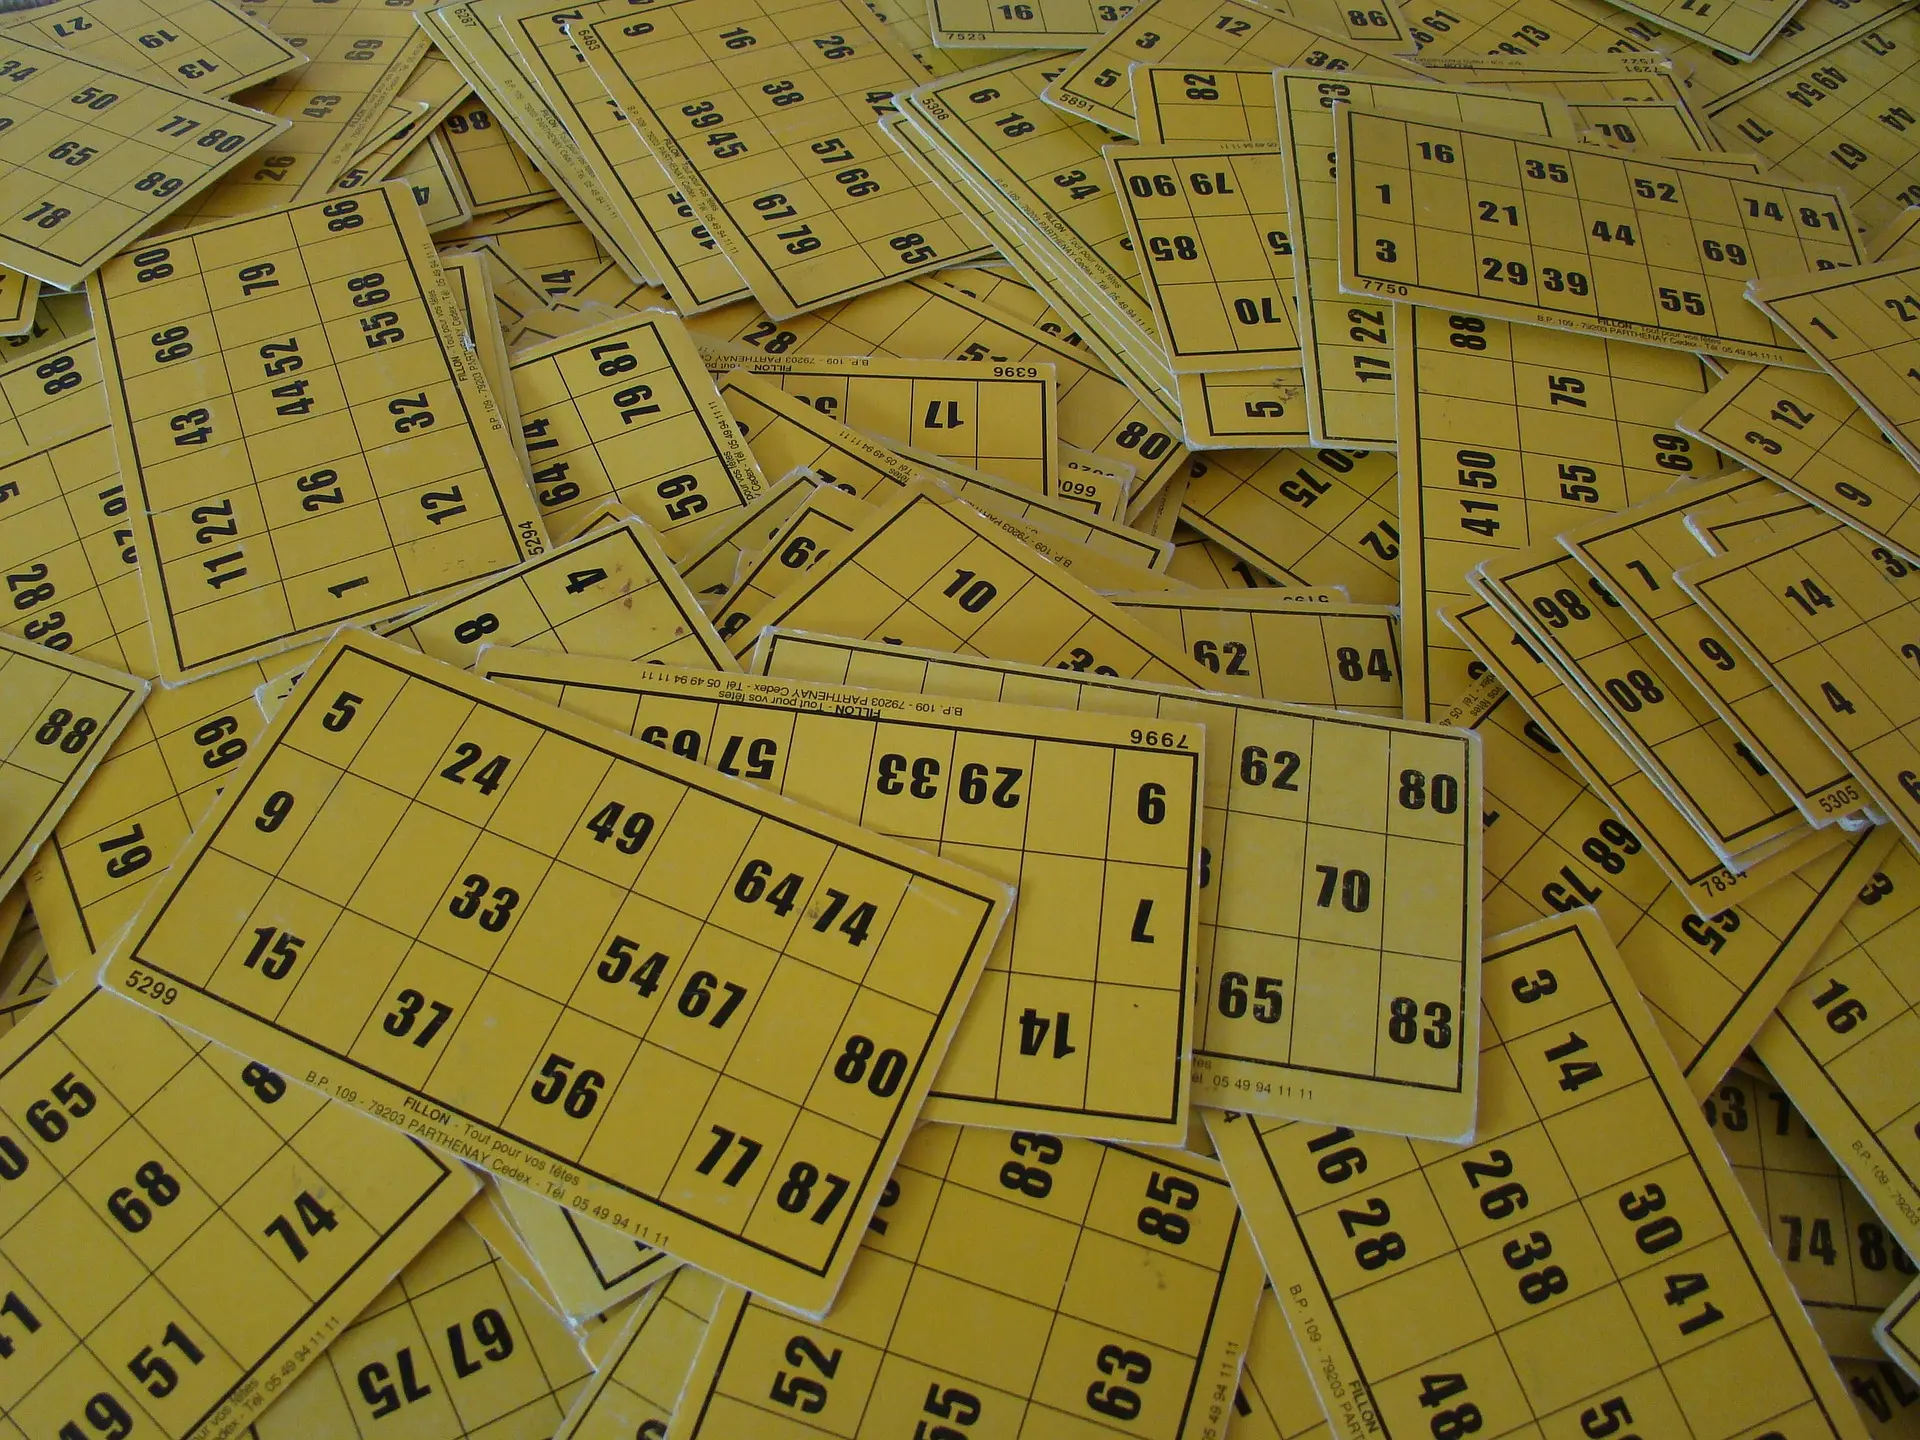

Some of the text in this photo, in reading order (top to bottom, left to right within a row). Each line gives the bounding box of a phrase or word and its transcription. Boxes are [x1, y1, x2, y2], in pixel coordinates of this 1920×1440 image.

[53, 17, 92, 37] 27
[454, 7, 477, 28] 6287
[624, 23, 654, 36] 9
[1216, 16, 1251, 36] 12
[1348, 11, 1388, 26] 86
[1422, 10, 1460, 31] 61
[139, 30, 178, 48] 19
[577, 29, 601, 51] 6483
[814, 36, 854, 59] 26
[946, 33, 986, 41] 7523
[1136, 32, 1160, 49] 3
[1513, 25, 1550, 47] 73
[0, 61, 38, 82] 34
[71, 87, 118, 109] 50
[970, 89, 1000, 103] 6
[1184, 74, 1218, 100] 82
[682, 102, 723, 128] 39
[921, 98, 950, 120] 5308
[1060, 94, 1095, 112] 5891
[157, 116, 200, 137] 77
[996, 113, 1035, 137] 18
[48, 142, 98, 166] 65
[197, 130, 245, 152] 80
[811, 138, 854, 163] 57
[1417, 142, 1454, 163] 16
[1831, 143, 1867, 170] 67
[1130, 175, 1176, 197] 90
[1190, 173, 1233, 195] 79
[1376, 184, 1390, 204] 1
[1635, 179, 1678, 203] 52
[23, 202, 71, 228] 78
[323, 200, 363, 231] 86
[753, 194, 797, 220] 67
[1744, 198, 1783, 221] 74
[1592, 221, 1635, 246] 44
[890, 234, 937, 264] 85
[1376, 239, 1396, 262] 3
[134, 248, 173, 282] 80
[348, 273, 390, 307] 68
[1363, 280, 1408, 296] 7750
[1543, 268, 1588, 296] 39
[1234, 298, 1281, 324] 70
[1659, 288, 1705, 315] 55
[743, 321, 797, 353] 28
[1348, 309, 1386, 343] 22
[1810, 317, 1837, 339] 1
[260, 338, 303, 377] 52
[591, 342, 637, 376] 87
[1354, 356, 1391, 382] 17
[36, 356, 82, 395] 88
[993, 366, 1038, 378] 6396
[171, 409, 212, 445] 43
[925, 401, 964, 428] 17
[1116, 422, 1171, 460] 80
[1653, 434, 1693, 471] 69
[1745, 432, 1782, 454] 3
[1457, 450, 1497, 489] 50
[1558, 464, 1598, 503] 55
[421, 486, 466, 525] 12
[191, 498, 239, 547] 22
[517, 519, 546, 558] 5294
[328, 577, 369, 598] 1
[566, 568, 607, 594] 4
[1626, 560, 1659, 591] 7
[944, 569, 996, 612] 10
[1699, 638, 1735, 670] 9
[641, 671, 654, 680] 11
[658, 673, 670, 682] 11
[674, 675, 688, 685] 94
[690, 677, 704, 686] 49
[707, 679, 721, 688] 05
[748, 694, 768, 702] vos
[754, 684, 789, 696] Cedex
[771, 697, 797, 708] pour
[792, 689, 869, 706] PARTHENAY
[872, 698, 905, 710] 79203
[1605, 670, 1664, 712] 80
[323, 691, 363, 732] 5
[799, 701, 824, 713] Tout
[835, 705, 881, 717] FILLON
[915, 704, 935, 713] 109
[35, 709, 97, 754] 88
[194, 716, 247, 768] 69
[1130, 729, 1190, 750] 7996
[441, 743, 510, 795] 24
[717, 736, 777, 780] 57
[877, 754, 939, 799] 33
[959, 763, 1022, 808] 29
[1138, 783, 1165, 824] 9
[1399, 770, 1457, 814] 80
[1817, 786, 1859, 814] 5305
[255, 791, 294, 832] 9
[734, 860, 803, 917] 64
[1316, 865, 1370, 913] 70
[449, 874, 519, 932] 33
[813, 888, 877, 946] 74
[1131, 899, 1154, 943] 7
[597, 936, 669, 998] 54
[124, 970, 178, 1006] 5299
[1512, 970, 1557, 1003] 3
[1813, 979, 1867, 1033] 16
[1020, 1009, 1075, 1059] 14
[1389, 997, 1451, 1049] 83
[834, 1036, 907, 1097] 80
[1545, 1032, 1602, 1091] 14
[531, 1054, 604, 1119] 56
[1213, 1075, 1312, 1100] 05 49 94 11 11
[404, 1096, 451, 1125] FILLON
[464, 1124, 490, 1146] Tout
[492, 1139, 521, 1162] pour
[524, 1152, 546, 1171] vos
[335, 1084, 358, 1102] 109
[368, 1099, 404, 1124] 79203
[408, 1118, 489, 1164] PARTHENAY
[492, 1158, 531, 1184] Cedex
[572, 1196, 589, 1211] 05
[592, 1204, 609, 1219] 49
[612, 1212, 629, 1228] 94
[634, 1223, 648, 1236] 11
[655, 1232, 669, 1246] 11
[696, 1125, 762, 1187] 77
[1000, 1132, 1063, 1198] 83
[1307, 1127, 1367, 1184] 16
[108, 1161, 180, 1233] 68
[777, 1162, 850, 1225] 87
[1138, 1172, 1199, 1244] 85
[1619, 1184, 1682, 1254] 30
[264, 1191, 338, 1262] 74
[1665, 1274, 1724, 1335] 41
[447, 1309, 513, 1378] 67
[1087, 1345, 1151, 1420] 63
[1349, 1380, 1379, 1433] FILLON
